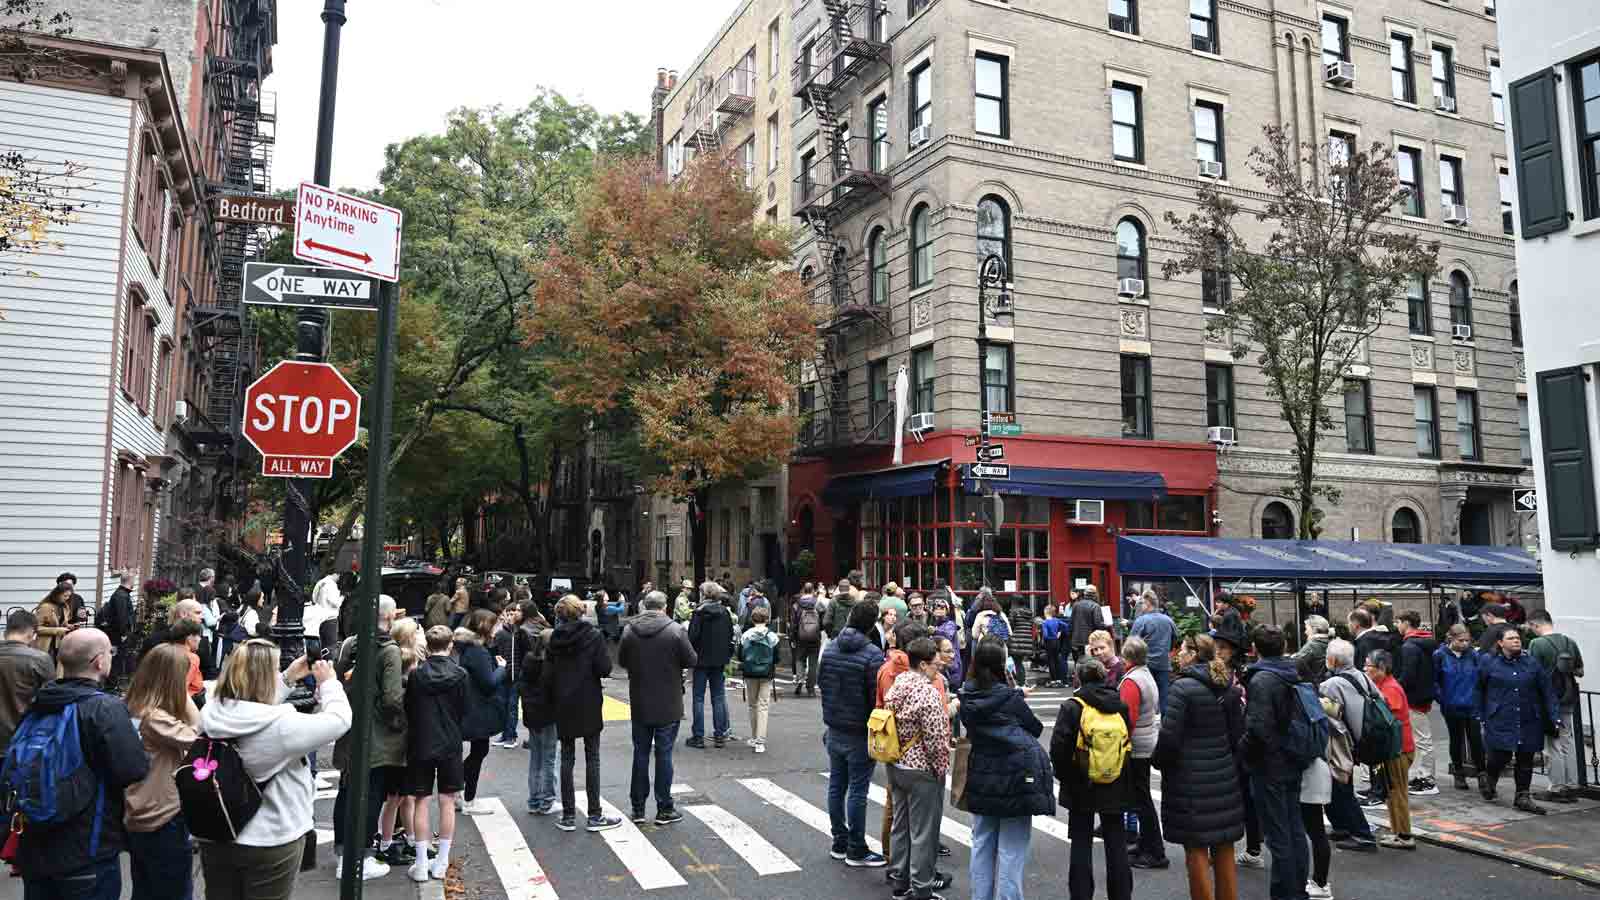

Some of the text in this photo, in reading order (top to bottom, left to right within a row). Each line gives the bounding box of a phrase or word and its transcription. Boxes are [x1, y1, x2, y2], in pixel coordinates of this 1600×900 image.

[219, 198, 284, 223] Bedford
[305, 191, 379, 224] NO PARKING
[303, 210, 355, 235] Anytime
[266, 276, 363, 297] ONE WAY
[252, 393, 352, 434] STOP
[271, 460, 325, 473] ALL WAY
[1524, 496, 1536, 504] ON
